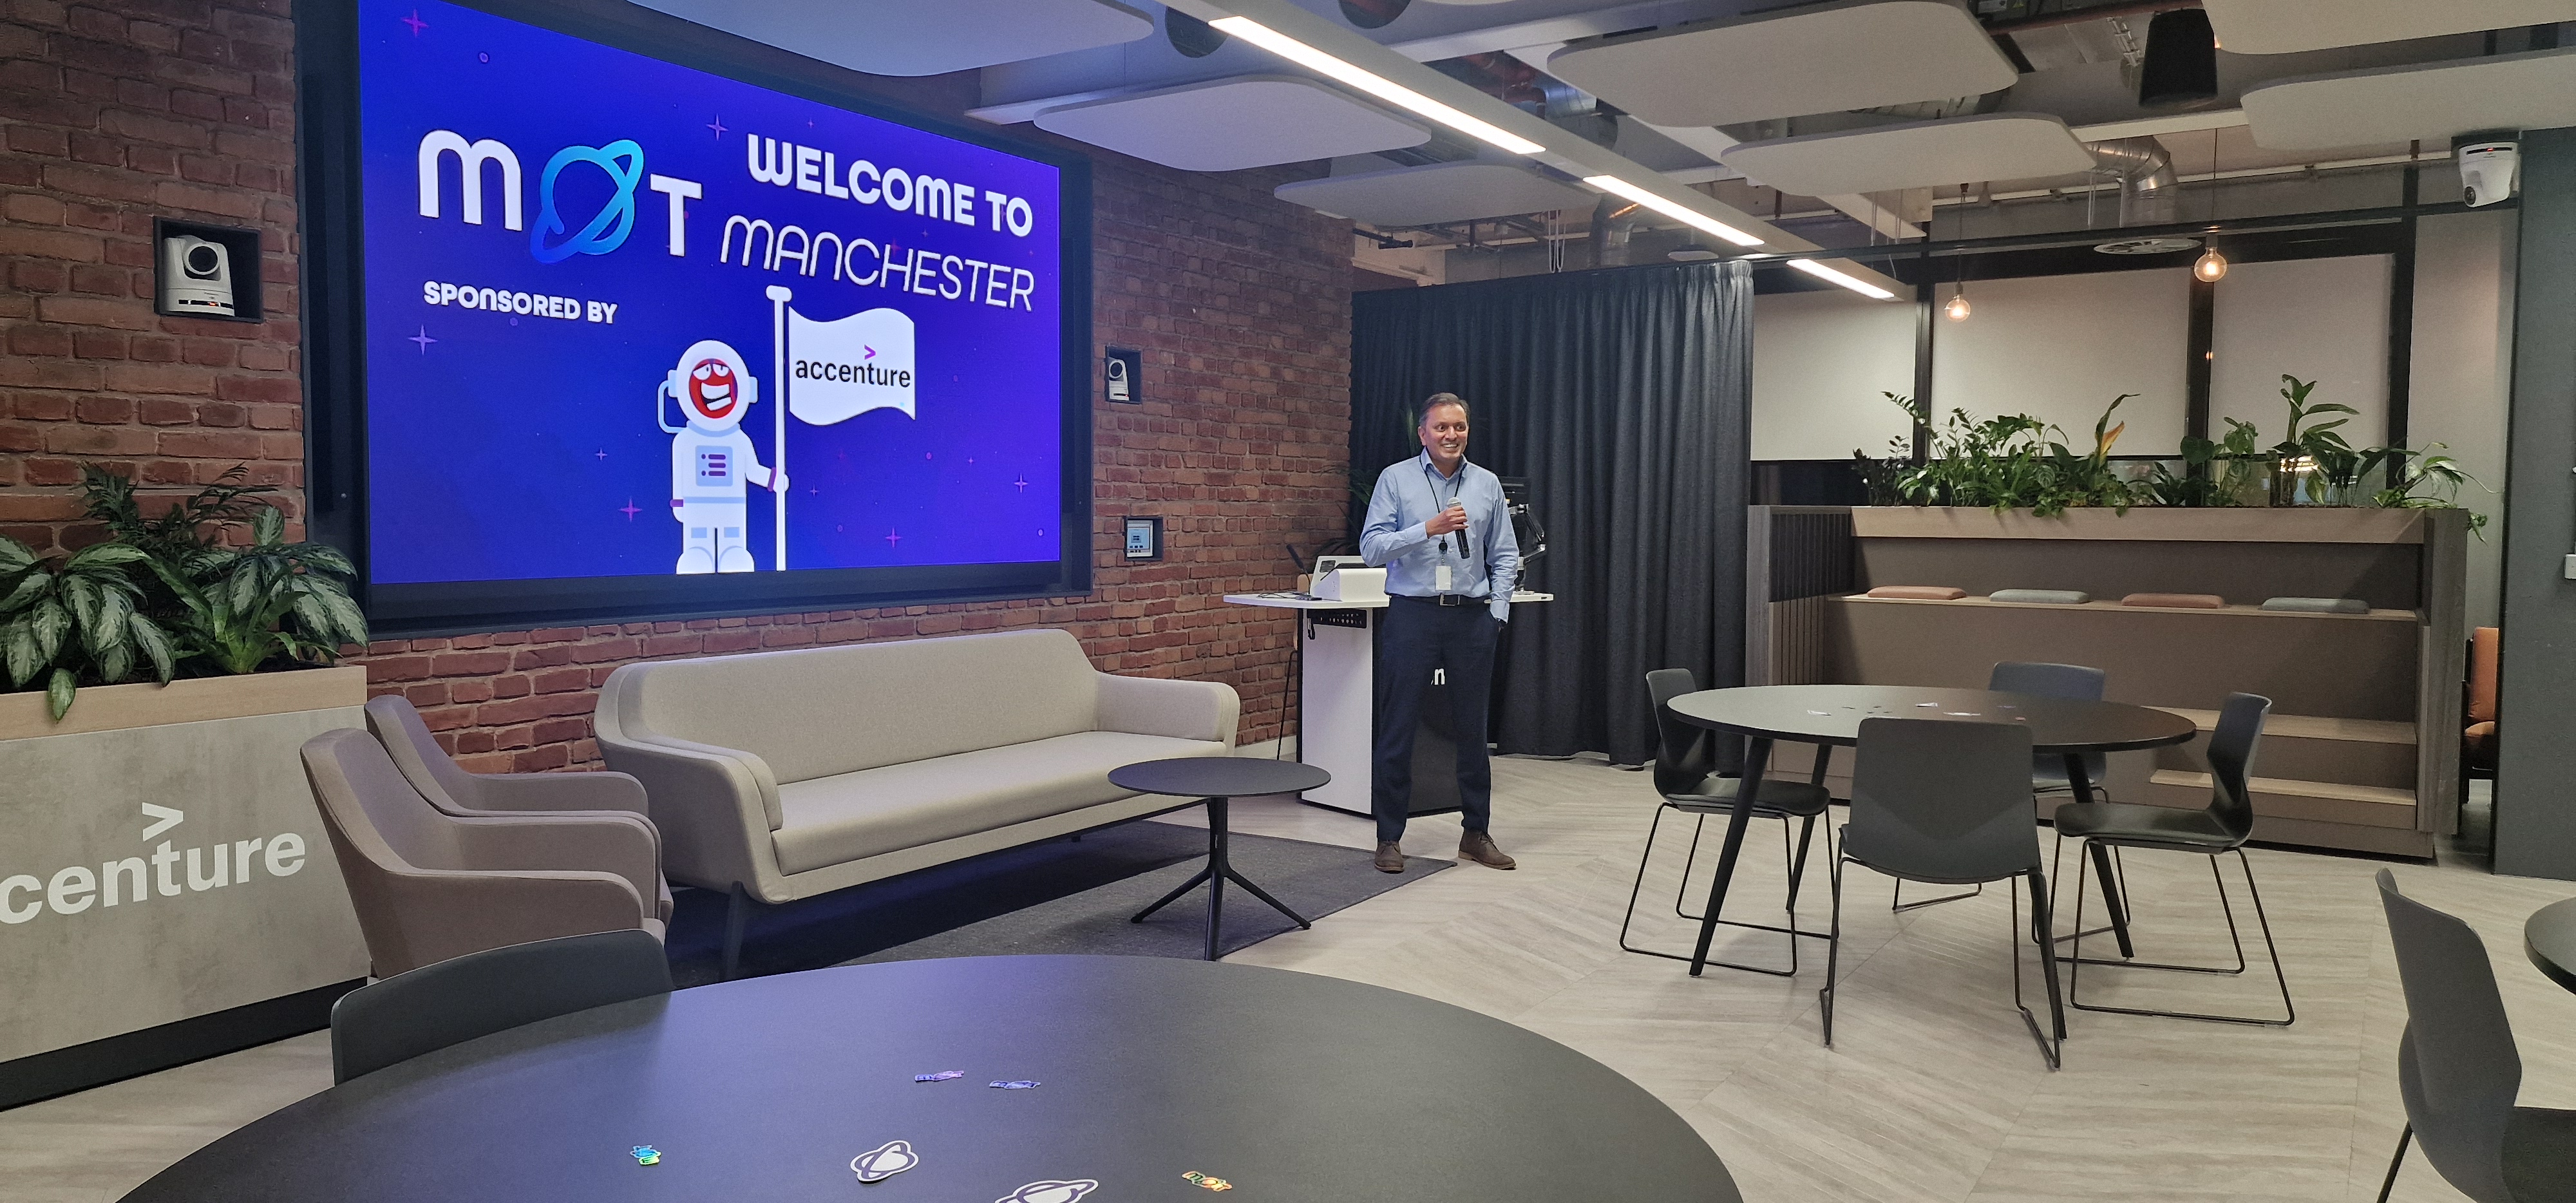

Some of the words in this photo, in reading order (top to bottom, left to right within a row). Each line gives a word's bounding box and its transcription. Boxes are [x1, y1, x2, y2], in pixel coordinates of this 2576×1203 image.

[748, 133, 975, 226] WELCOME
[985, 191, 1033, 237] TO
[720, 214, 1034, 311] MANCHESTER
[423, 281, 581, 319] SPONSORED
[587, 301, 618, 324] BY
[795, 360, 911, 388] accenture
